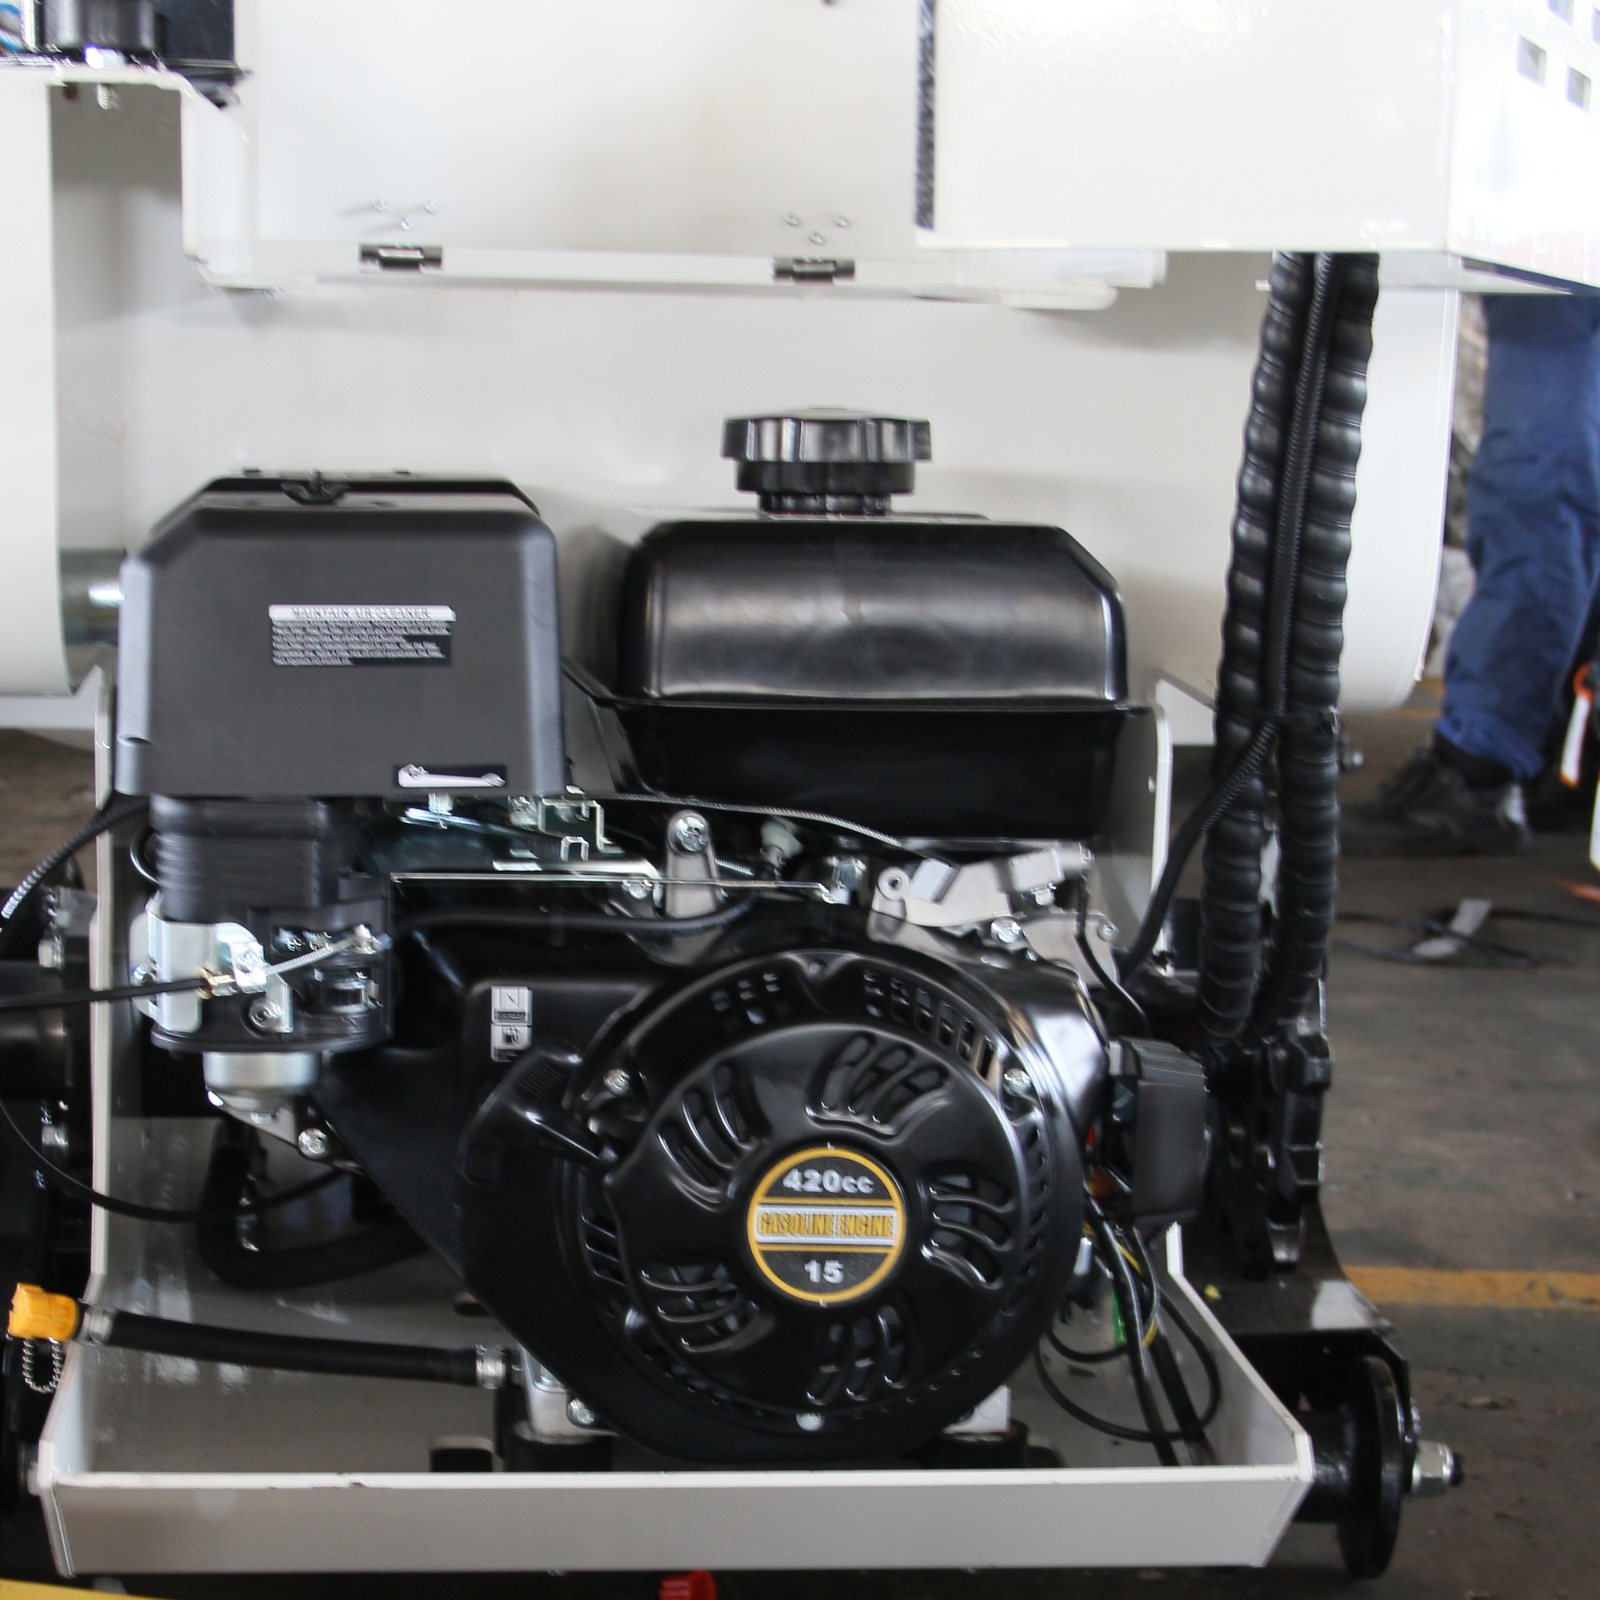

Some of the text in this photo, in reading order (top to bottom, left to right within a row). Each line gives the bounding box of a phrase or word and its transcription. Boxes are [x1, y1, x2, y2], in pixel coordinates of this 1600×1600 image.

[291, 606, 432, 620] MAINTAIN AIR CLEANER
[782, 1168, 874, 1194] 420cc
[760, 1212, 894, 1238] GASOLINE ENGINE
[804, 1259, 844, 1284] 15
